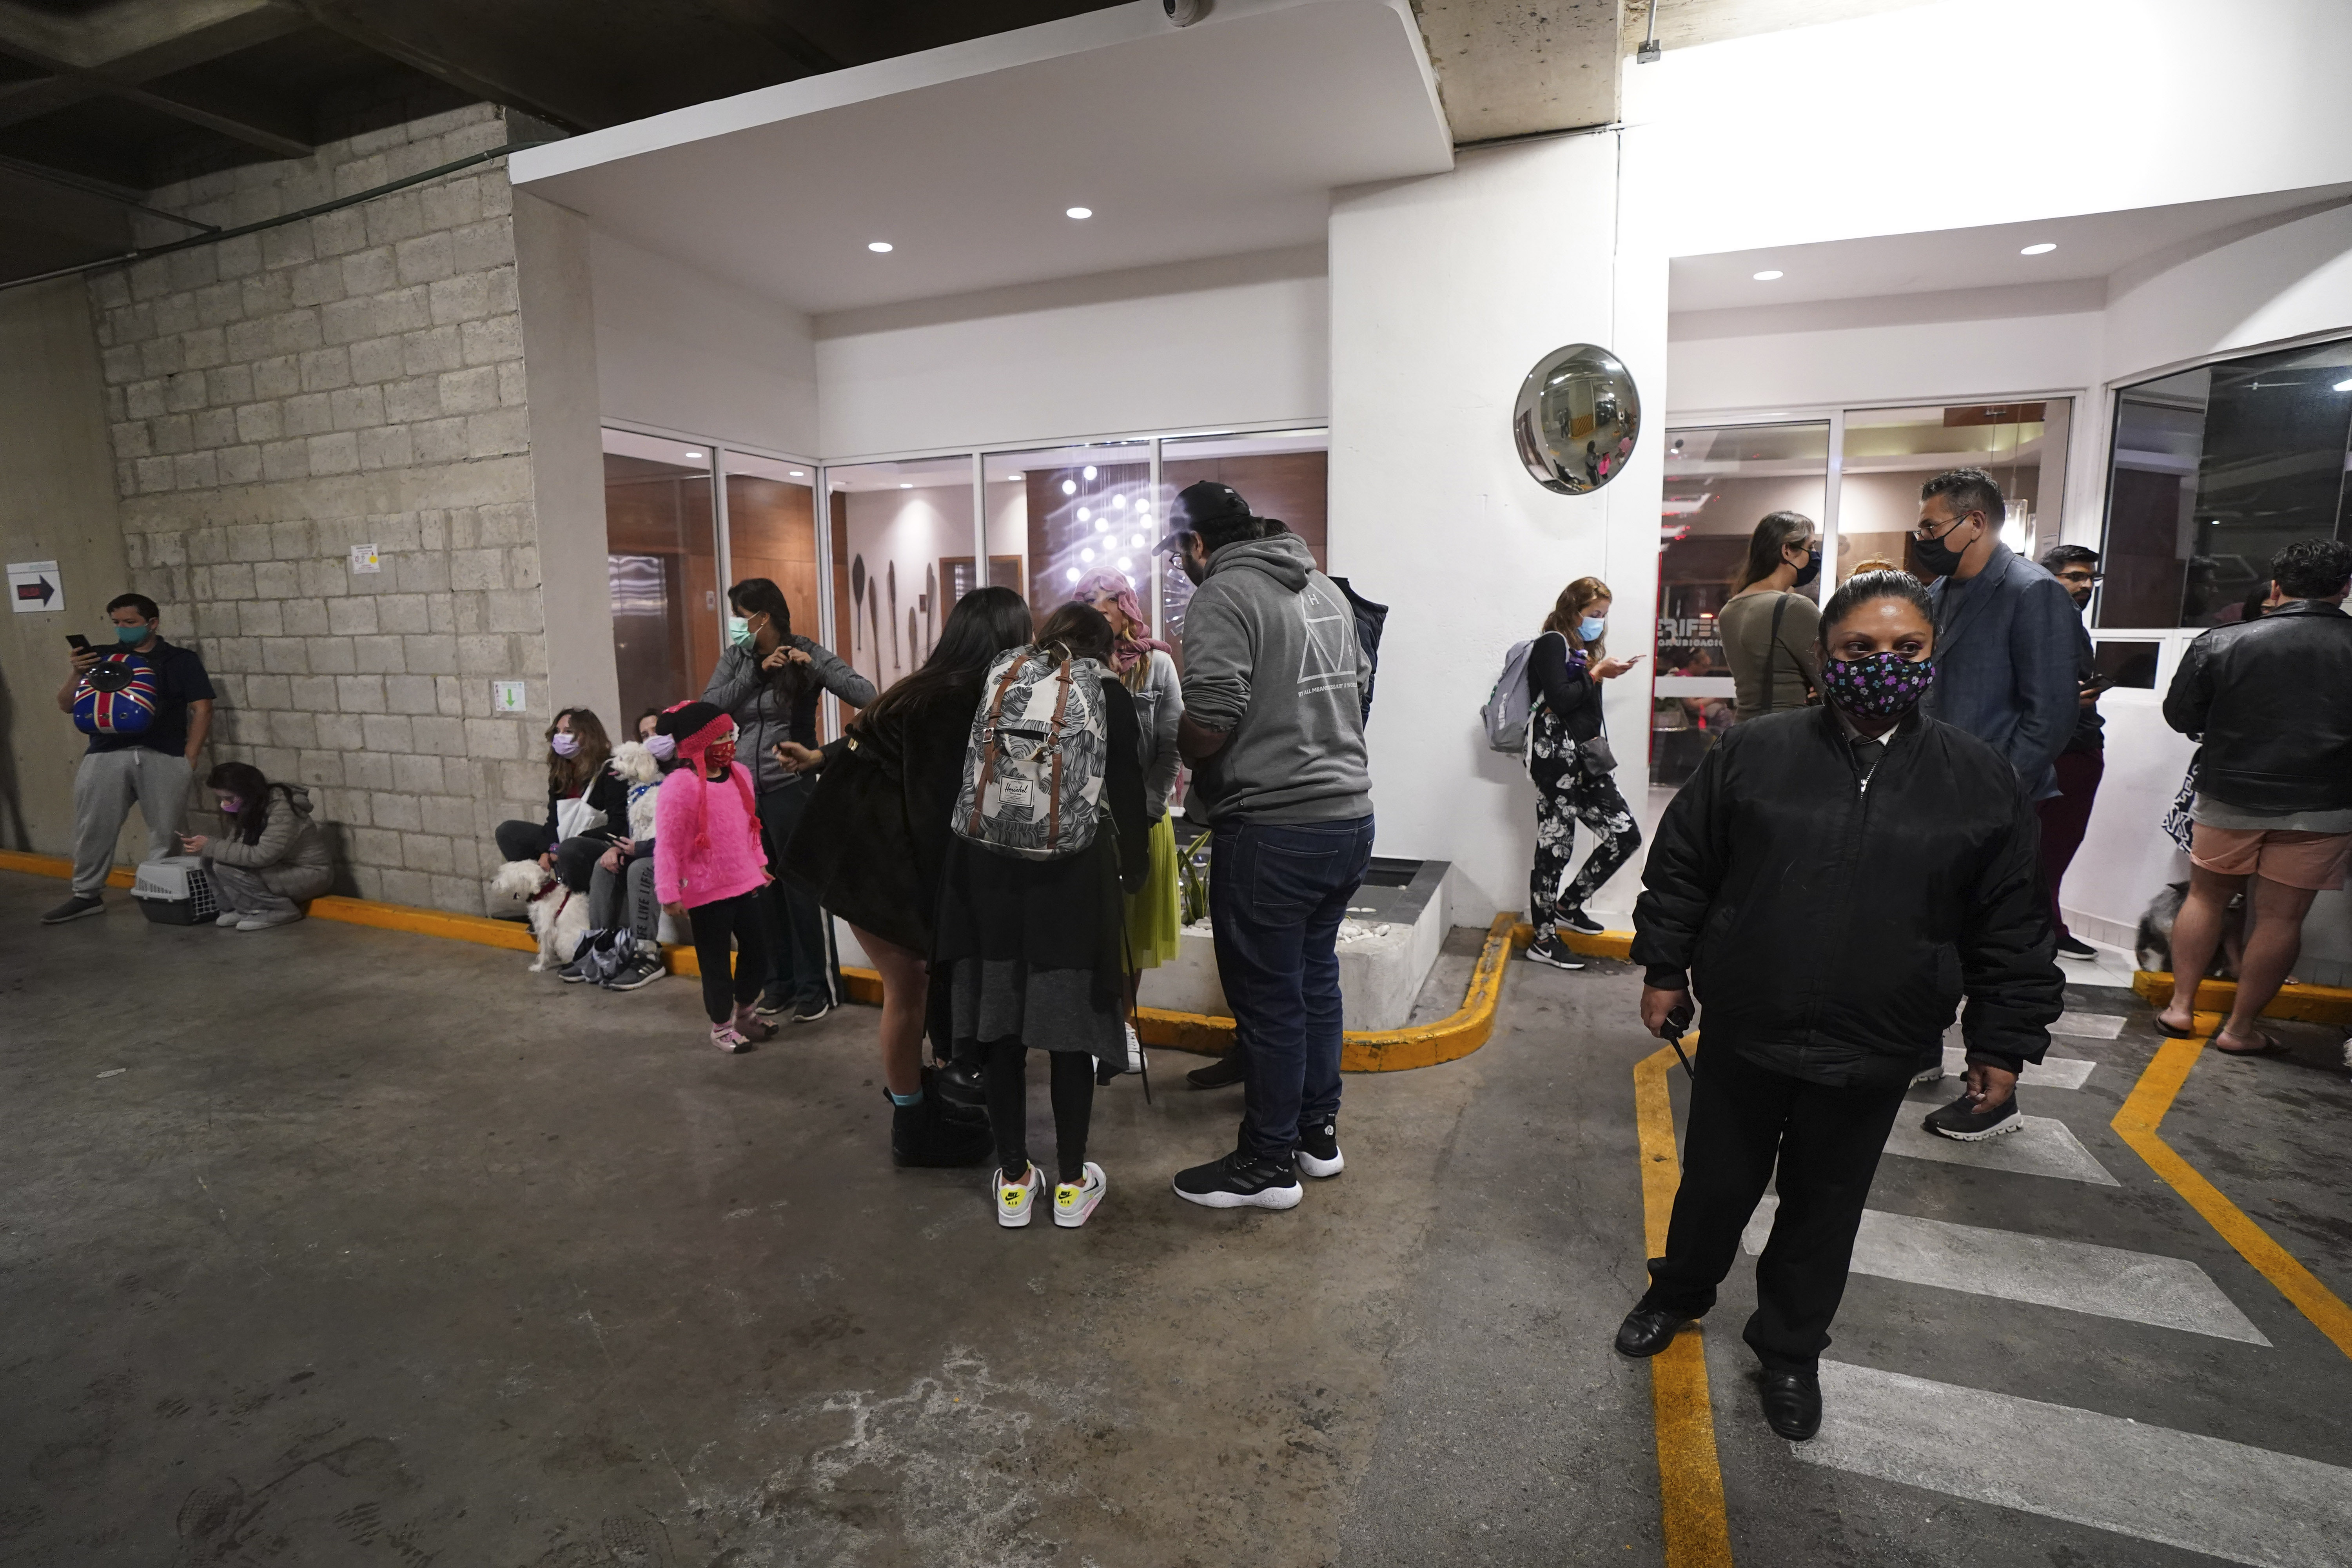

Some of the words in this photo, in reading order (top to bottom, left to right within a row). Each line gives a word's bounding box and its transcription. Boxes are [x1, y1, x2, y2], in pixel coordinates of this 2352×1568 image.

[1308, 594, 1319, 605] H
[1005, 782, 1028, 793] Herschel
[638, 897, 649, 921] LIVE
